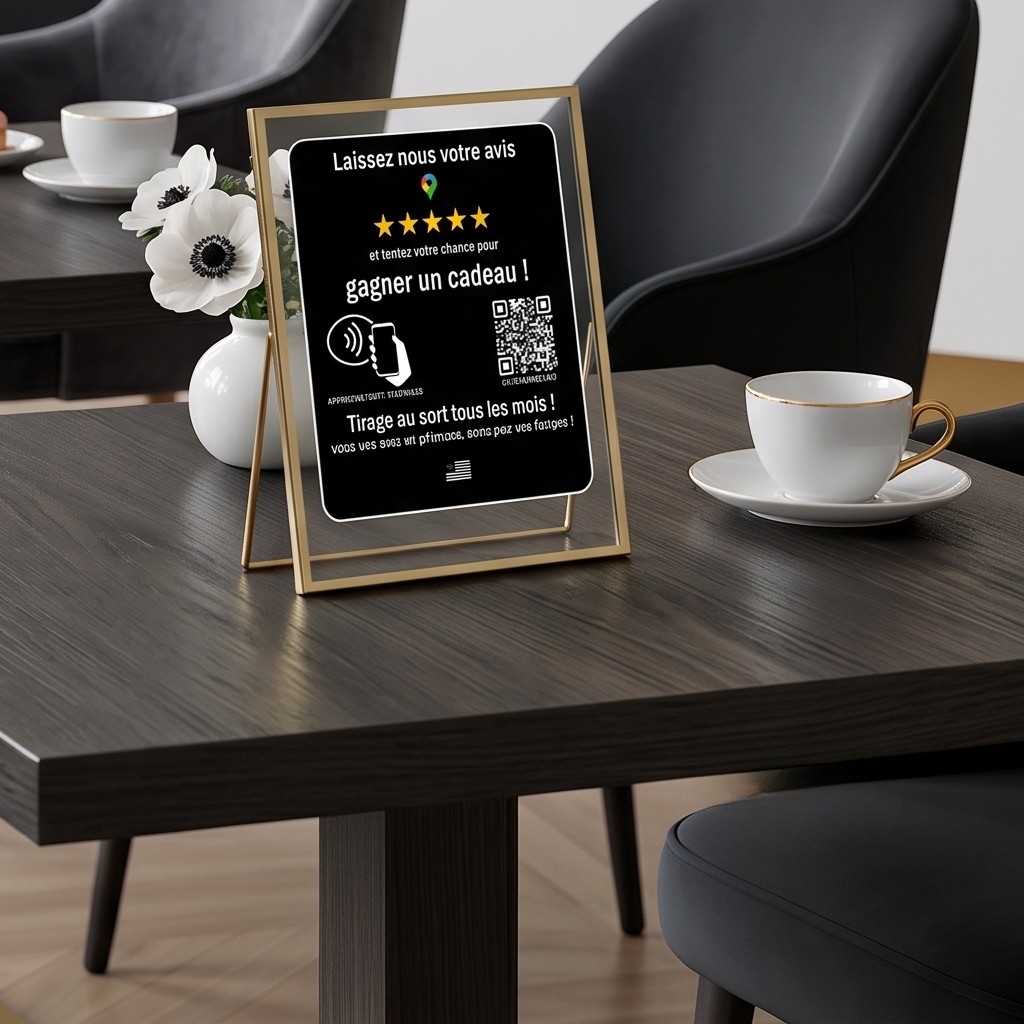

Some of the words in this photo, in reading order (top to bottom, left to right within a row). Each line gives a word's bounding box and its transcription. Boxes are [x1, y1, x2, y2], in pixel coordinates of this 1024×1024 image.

[332, 150, 395, 172] Laissez
[397, 149, 437, 167] nous
[439, 144, 481, 163] votre
[484, 138, 516, 160] avis
[369, 249, 380, 262] et
[380, 247, 413, 260] tentez
[413, 244, 439, 257] votre
[440, 242, 475, 255] chance
[476, 240, 499, 254] pour
[345, 274, 413, 305] gagner
[417, 272, 443, 292] un
[447, 262, 517, 289] cadeau
[522, 258, 529, 282] !
[346, 413, 394, 434] Tirage
[396, 412, 416, 428] au
[418, 405, 450, 426] sort
[450, 404, 485, 422] tous
[486, 399, 509, 418] les
[511, 394, 548, 416] mois
[549, 393, 556, 411] !
